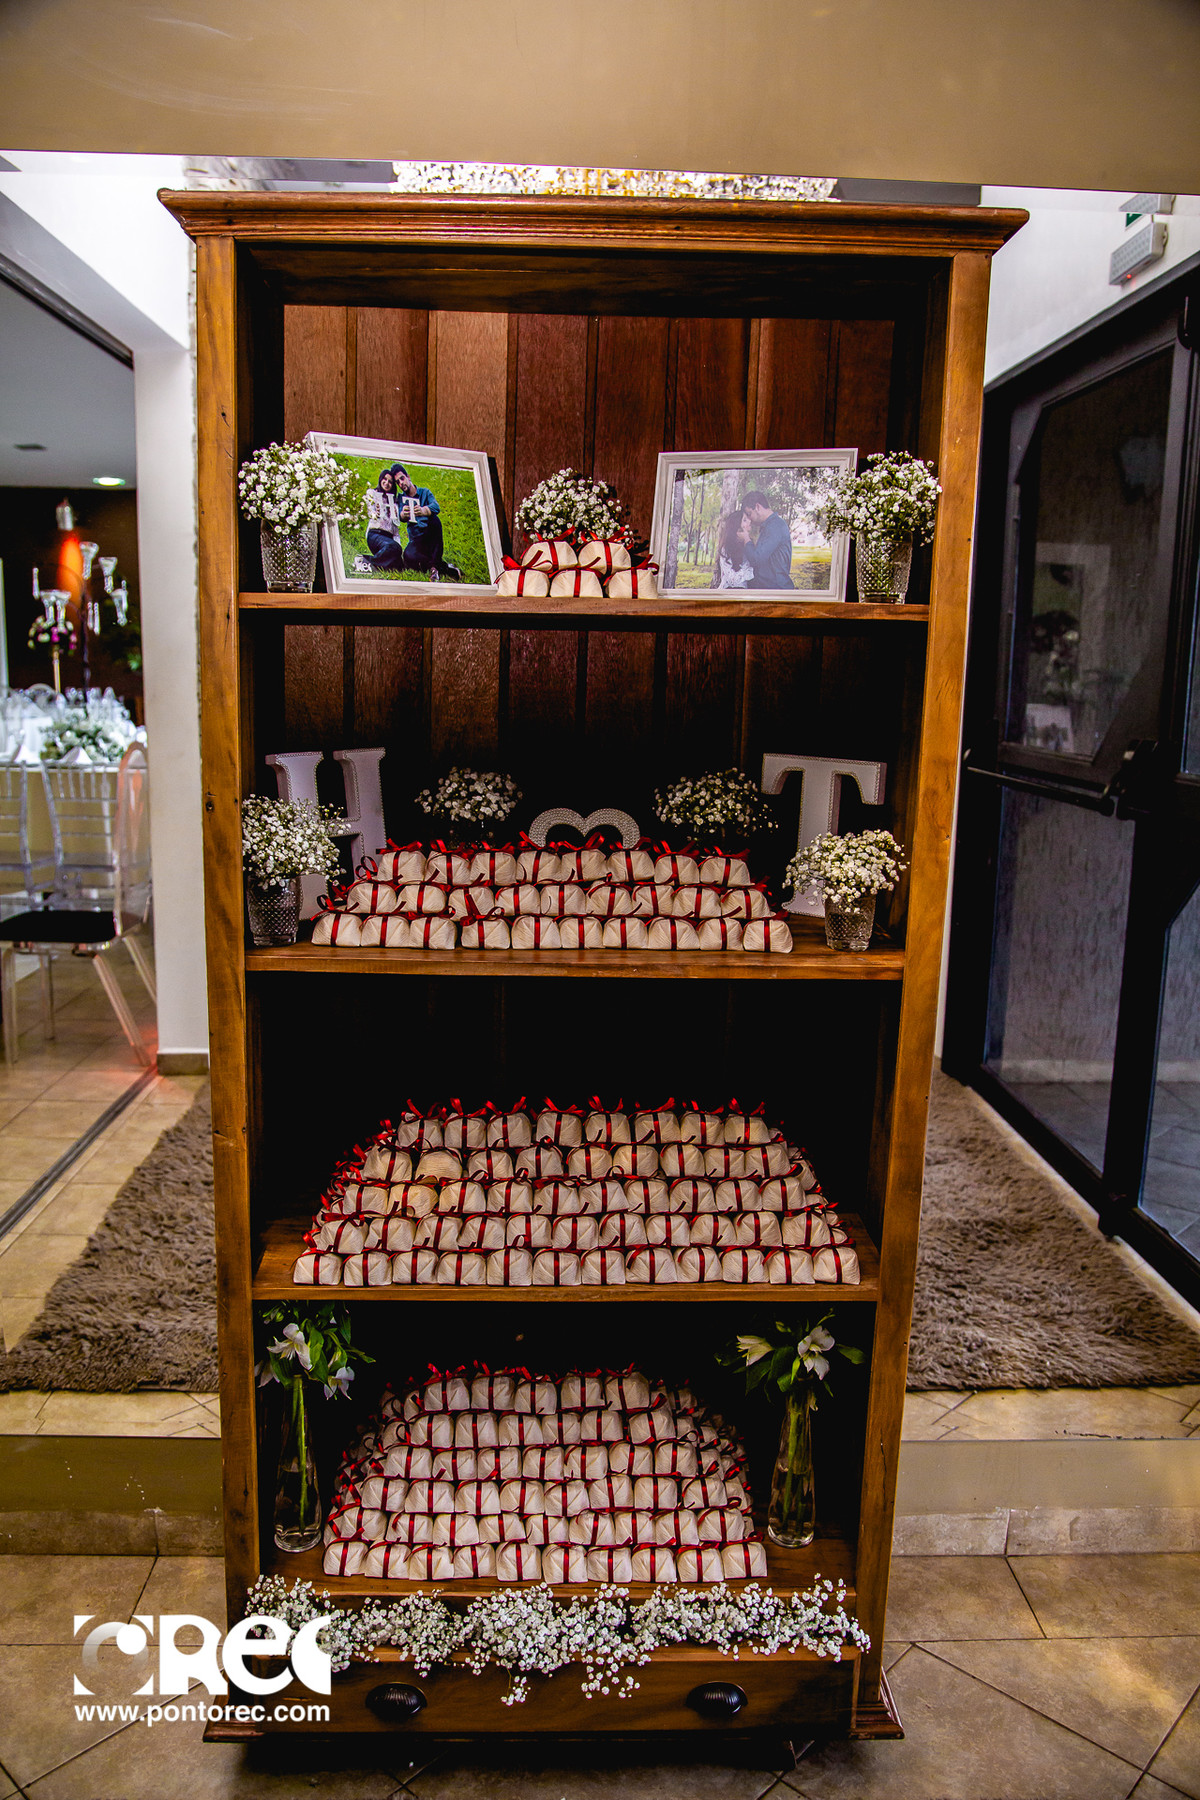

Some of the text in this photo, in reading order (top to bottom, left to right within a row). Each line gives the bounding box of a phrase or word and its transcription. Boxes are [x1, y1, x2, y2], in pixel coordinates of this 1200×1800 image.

[402, 496, 420, 523] T
[265, 747, 888, 921] H T
